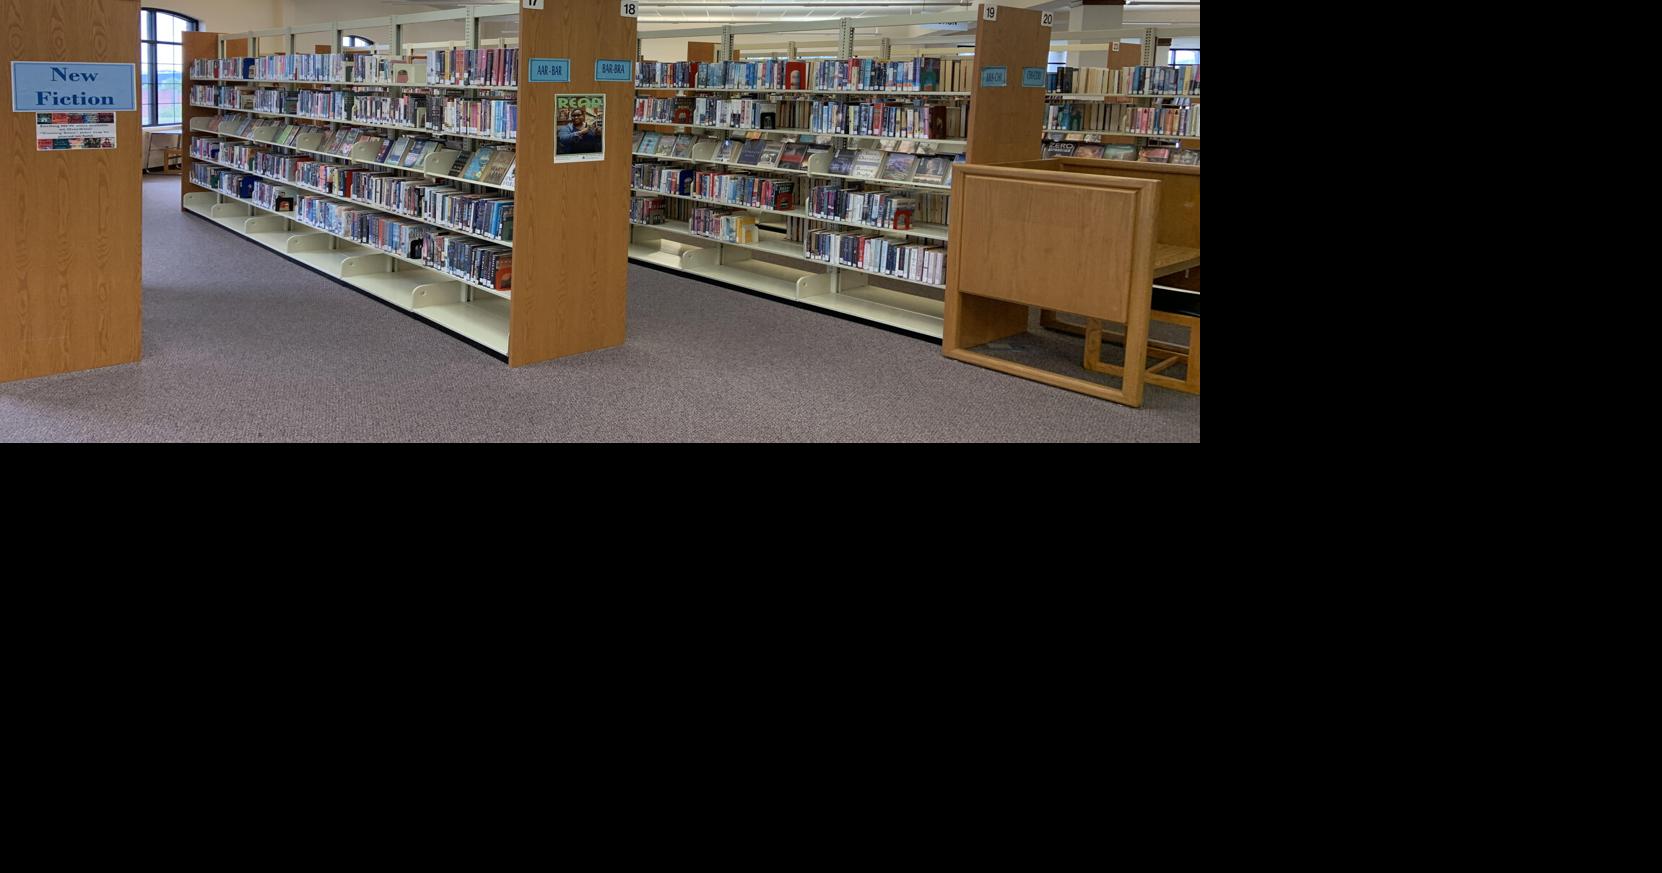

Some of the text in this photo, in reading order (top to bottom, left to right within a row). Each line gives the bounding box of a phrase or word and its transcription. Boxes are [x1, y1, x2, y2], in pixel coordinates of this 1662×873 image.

[624, 4, 636, 15] 18
[986, 7, 995, 18] 19
[1043, 14, 1053, 24] 20
[50, 66, 99, 82] New
[35, 91, 115, 106] Fiction
